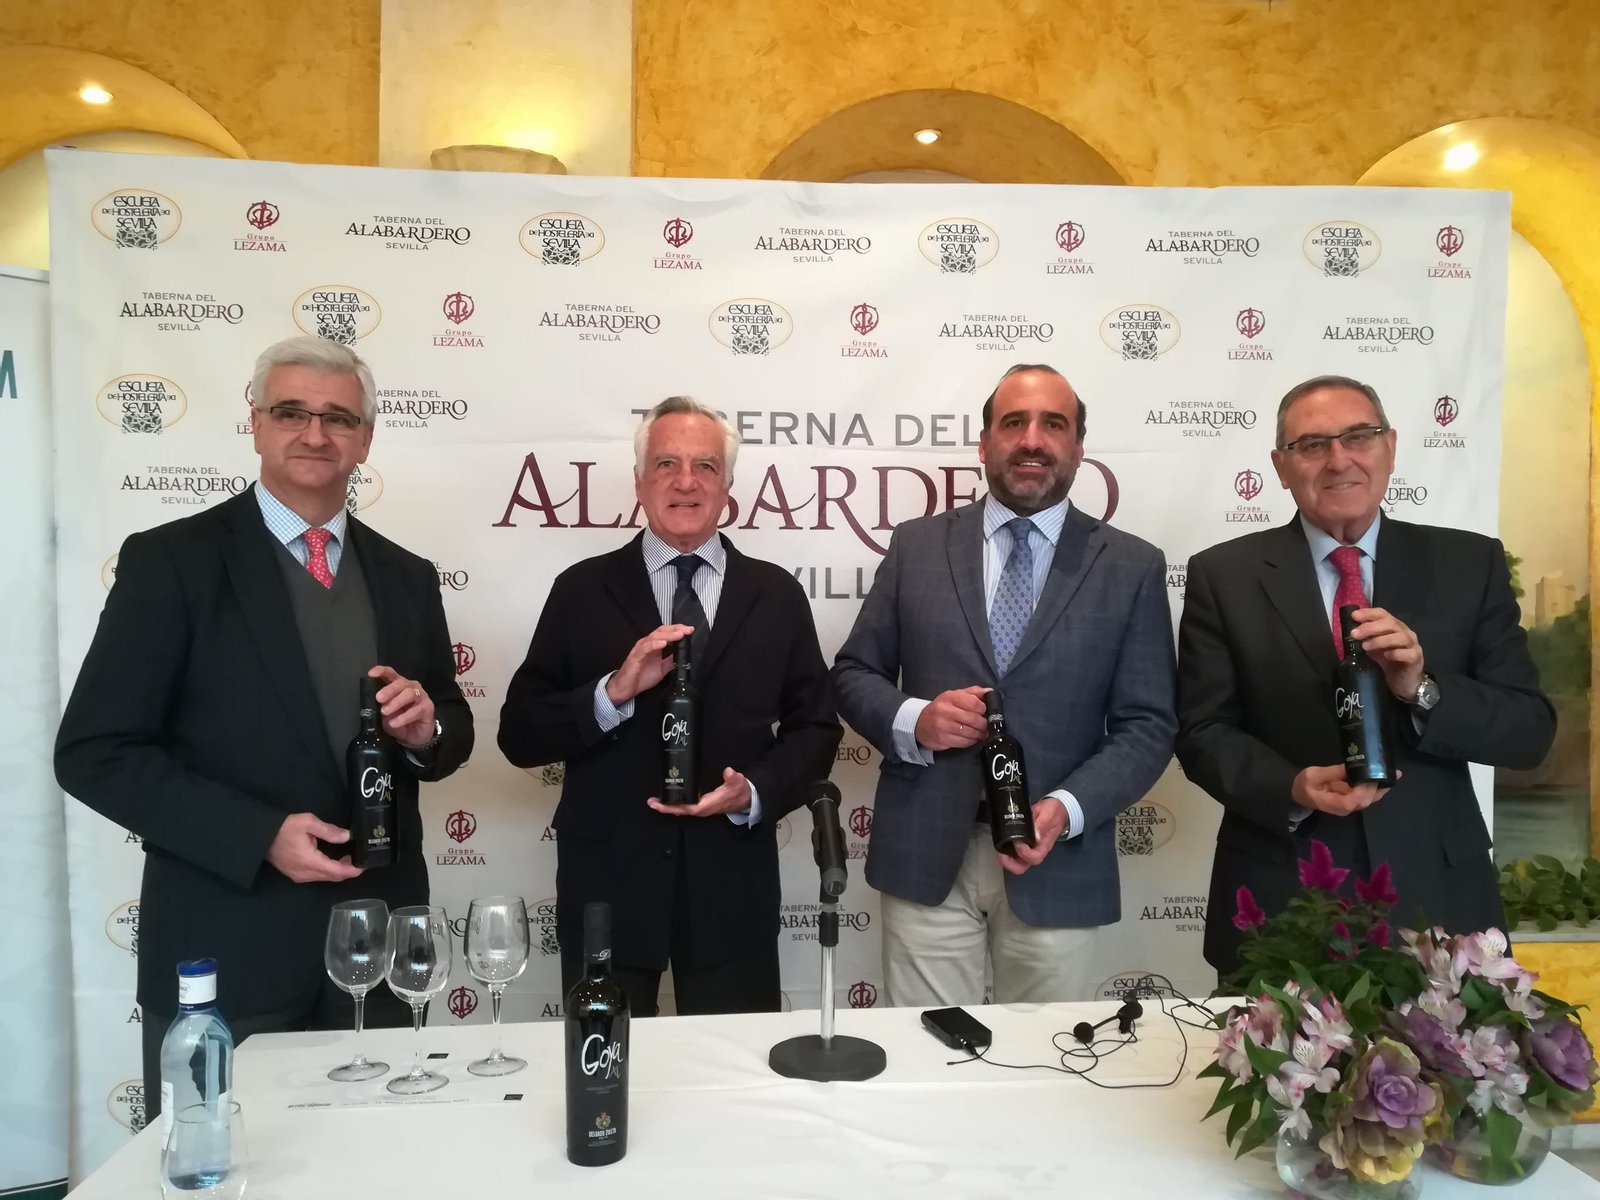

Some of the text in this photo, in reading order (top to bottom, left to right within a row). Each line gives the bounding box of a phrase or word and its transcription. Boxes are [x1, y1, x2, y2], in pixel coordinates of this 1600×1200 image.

[116, 217, 157, 229] SEVILLA
[373, 216, 444, 225] TABERNA DEL
[344, 222, 470, 245] ALABARDERO
[779, 227, 846, 236] TABERNA DEL
[234, 241, 286, 252] LEZAMA
[386, 242, 428, 251] SEVILLA
[542, 238, 580, 248] SEVILLA
[754, 236, 871, 255] ALABARDERO
[1145, 238, 1260, 257] ALABARDERO
[940, 244, 976, 254] SEVILLA
[654, 260, 702, 270] LEZAMA
[1047, 265, 1094, 274] LEZAMA
[1427, 268, 1472, 278] LEZAMA
[142, 292, 216, 302] TABERNA DEL
[119, 302, 244, 324] ALABARDERO
[565, 304, 612, 312] TABERNA
[316, 314, 356, 324] SEVILLA
[538, 312, 660, 334] ALABARDERO
[963, 314, 1007, 322] TABERNA
[158, 323, 200, 331] SEVILLA
[732, 324, 770, 336] SEVILLA
[579, 333, 621, 341] SEVILLA
[938, 322, 1054, 343] ALABARDERO
[1122, 330, 1158, 341] SEVILLA
[1323, 325, 1434, 345] ALABARDERO
[433, 337, 484, 347] LEZAMA
[976, 343, 1015, 351] SEVILLA
[841, 348, 888, 357] LEZAMA
[1358, 345, 1398, 353] SEVILLA
[1228, 351, 1273, 360] LEZAMA
[422, 390, 441, 398] DEL
[122, 402, 162, 413] SEVILLA
[377, 399, 468, 420] BARDERO
[386, 420, 428, 428] SEVILLA
[1145, 410, 1256, 430] ALABARDERO
[631, 408, 981, 446] ERNA DEL
[1424, 439, 1465, 448] LEZAMA
[147, 466, 220, 475] TABERNA DEL
[120, 474, 247, 497] ALABARDERO
[161, 496, 206, 505] SEVILLA
[1226, 513, 1270, 522] LEZAMA
[1336, 688, 1364, 719] Goya
[662, 713, 690, 744] Goya
[992, 754, 1022, 782] Goya
[360, 767, 394, 801] Goya
[1118, 827, 1154, 837] SEVILLA
[436, 856, 486, 865] LEZAMA
[1163, 896, 1207, 904] TABERNA
[1140, 906, 1206, 921] ALABAR
[1176, 924, 1206, 932] SEVIL
[581, 1034, 623, 1079] Goya
